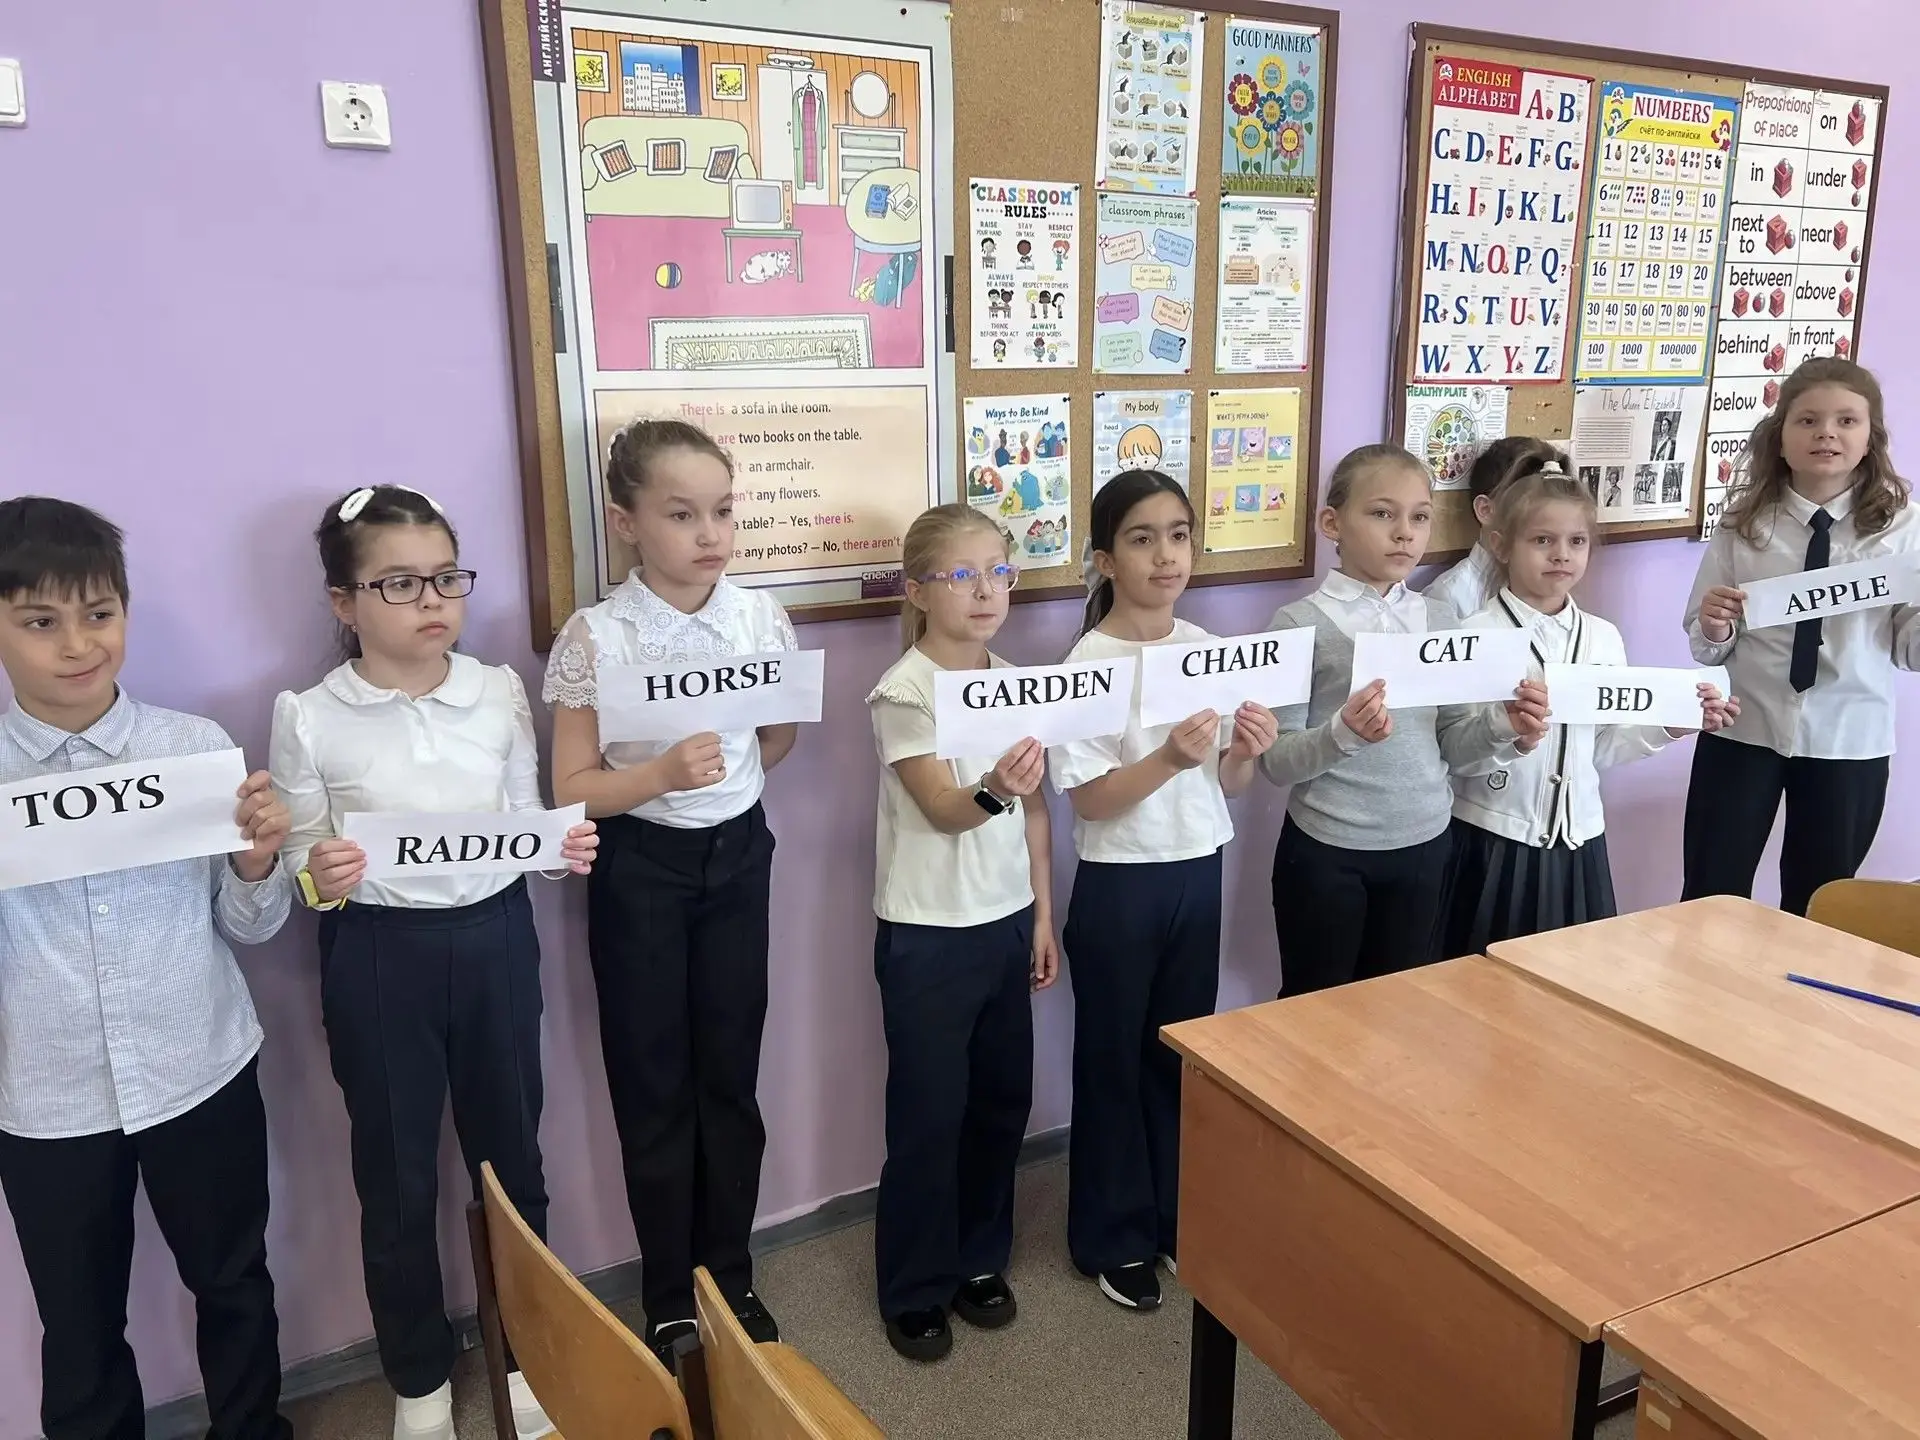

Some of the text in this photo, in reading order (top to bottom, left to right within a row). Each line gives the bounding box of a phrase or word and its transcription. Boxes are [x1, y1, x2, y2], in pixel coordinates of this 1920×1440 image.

[1233, 28, 1312, 53] GOOD MANNERS
[1457, 67, 1512, 88] ENGLISH
[1438, 85, 1518, 110] ALPHABET
[1525, 89, 1577, 123] A B
[1745, 91, 1813, 115] Prepositions
[1633, 96, 1712, 124] NUMBERS
[1754, 121, 1799, 138] of place
[1820, 114, 1837, 131] on
[1434, 128, 1572, 171] C D E F G
[1604, 143, 1713, 170] 1 2 3 4 5
[1750, 162, 1764, 182] in
[1807, 168, 1846, 188] under
[976, 186, 1072, 205] CLASSROOM
[1430, 183, 1566, 226] H I J K L
[1600, 184, 1716, 208] 6 7 8 9 10
[1005, 205, 1047, 218] RULES
[1109, 204, 1185, 220] classroom phrases
[1598, 223, 1713, 244] 11 12 13 14 15
[1732, 214, 1764, 233] next
[1739, 235, 1755, 253] to
[1801, 226, 1833, 243] near
[1426, 240, 1559, 284] M N O P Q
[1592, 261, 1708, 280] 16 17 18 19 20
[1730, 265, 1793, 287] between
[1796, 280, 1836, 300] above
[1422, 294, 1557, 327] R S T U V
[1587, 302, 1706, 317] 30 40 50 60 70 80 90
[1718, 334, 1770, 354] behind
[1789, 325, 1835, 345] in front
[1421, 344, 1550, 374] W X Y Z
[1588, 343, 1697, 355] 100 1000 1000000
[1407, 386, 1468, 397] HEALTHY PLATE
[1601, 388, 1619, 411] The
[1713, 391, 1757, 411] below
[680, 401, 831, 416] There is a sofa in the room.
[986, 406, 1049, 420] Ways to Be Kind
[1125, 400, 1159, 414] My body
[717, 428, 862, 445] are two books on the table.
[748, 462, 762, 473] an
[765, 458, 814, 472] armchair.
[756, 491, 776, 504] any
[779, 487, 821, 501] flowers.
[742, 516, 775, 530] table?
[790, 515, 811, 528] Yes,
[814, 513, 841, 525] there
[844, 512, 854, 523] is.
[744, 547, 764, 560] any
[767, 542, 808, 559] photos?
[823, 541, 840, 553] No,
[843, 538, 869, 551] there
[862, 570, 898, 581] спектр
[1785, 575, 1891, 616] APPLE
[1181, 640, 1280, 680] CHAIR
[1418, 636, 1480, 665] CAT
[643, 659, 782, 703] HORSE
[961, 667, 1114, 711] GARDEN
[1596, 686, 1653, 713] BED
[10, 774, 166, 829] TOYS
[393, 832, 541, 865] RADIO
